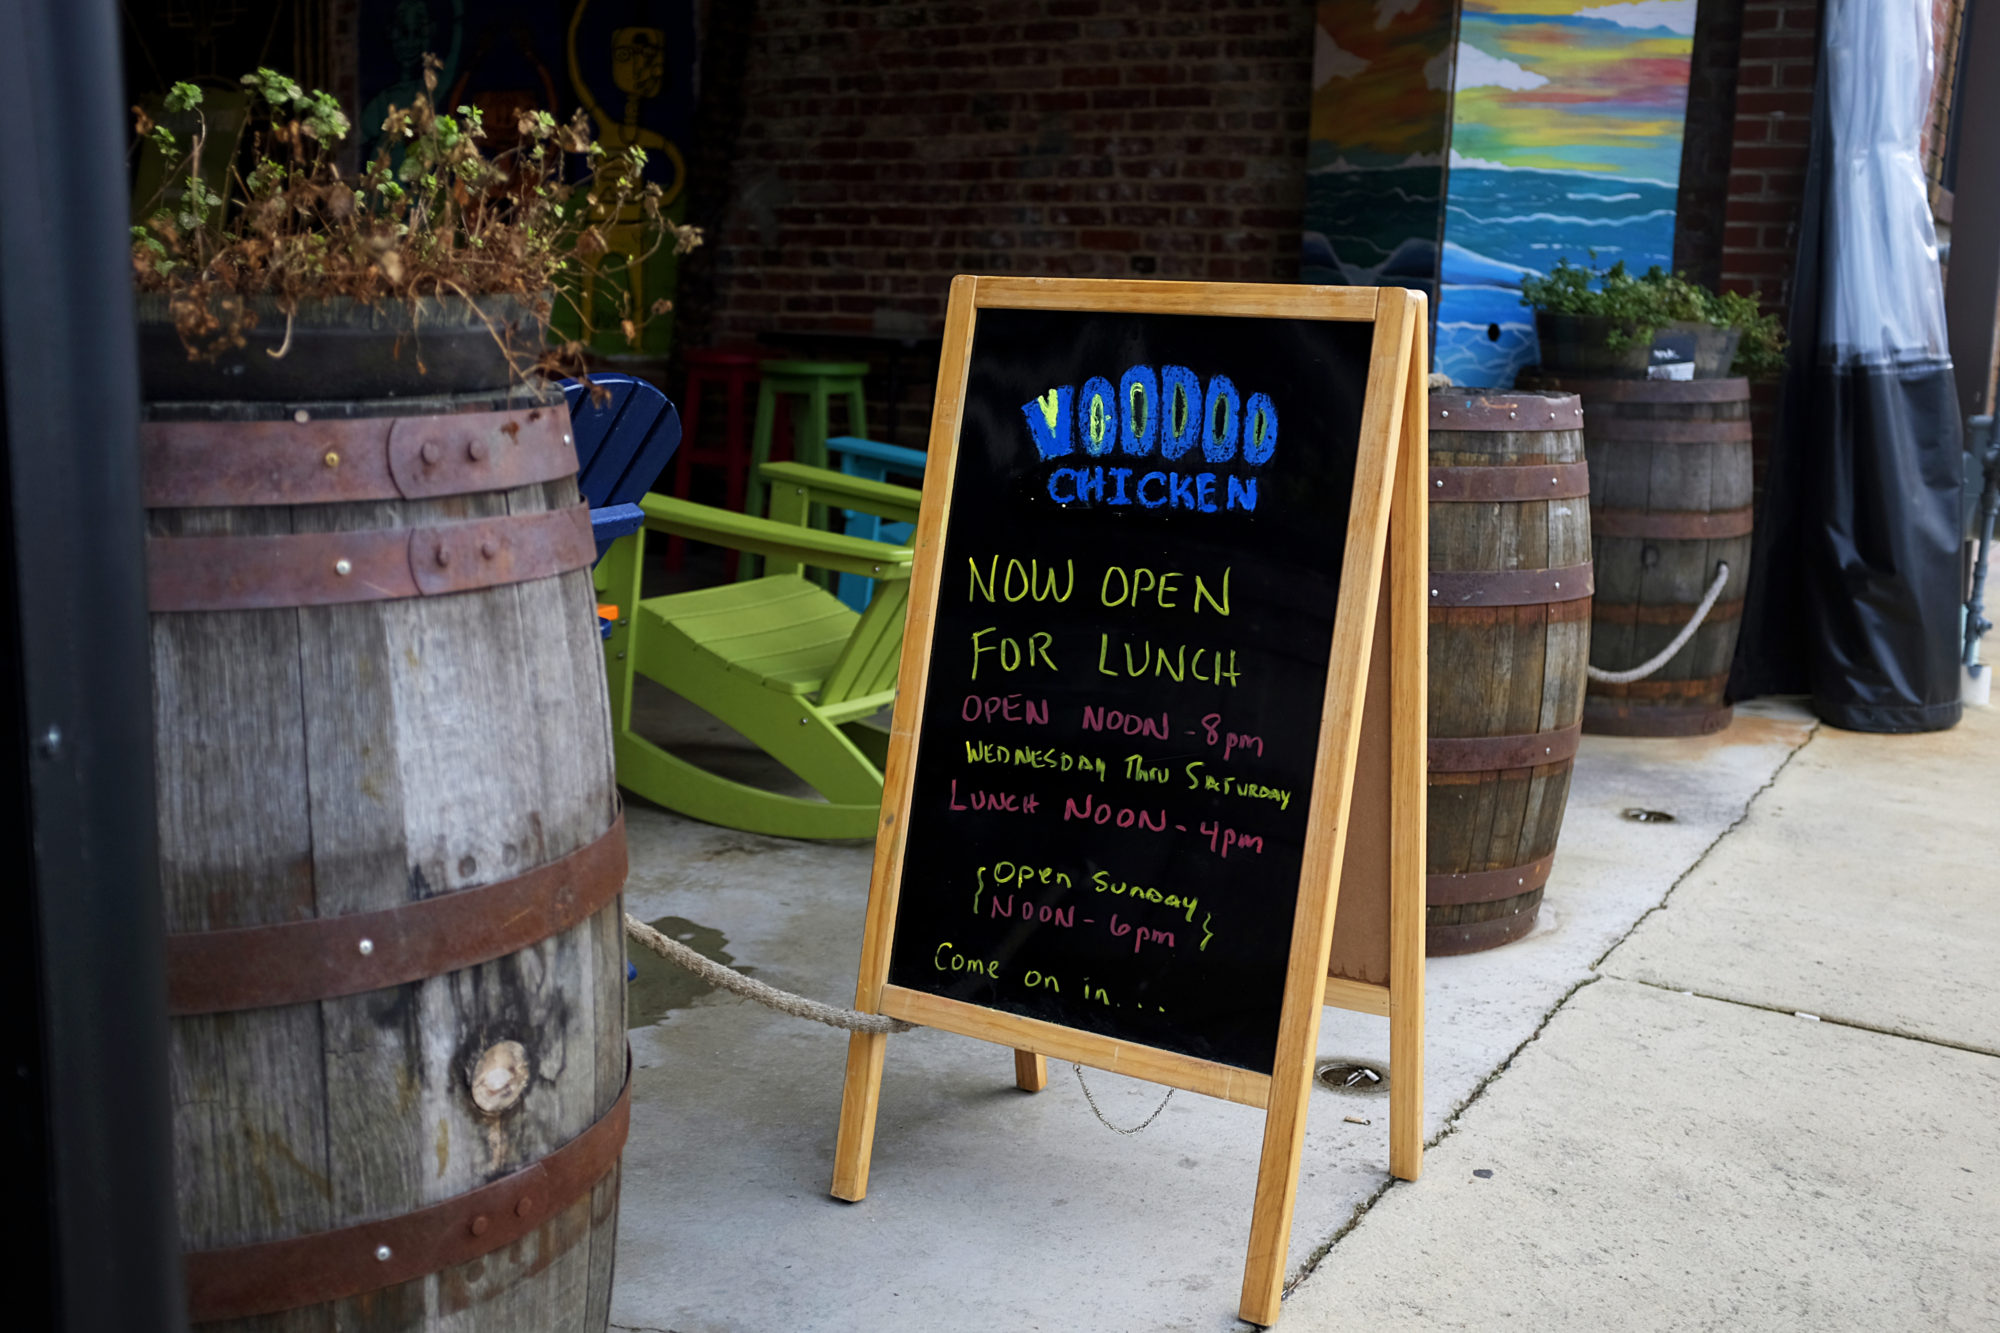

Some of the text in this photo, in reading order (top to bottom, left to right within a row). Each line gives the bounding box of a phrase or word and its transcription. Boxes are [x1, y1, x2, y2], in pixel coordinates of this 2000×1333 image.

[1020, 364, 1279, 466] VOODOO
[1047, 466, 1259, 513] CHICKEN
[968, 555, 1231, 615] NOW OPEN
[971, 627, 1242, 687] FOR LUNCH
[961, 695, 1050, 724] OPEN
[1082, 704, 1169, 740] NOON
[949, 779, 1041, 813] LUNCH
[994, 861, 1072, 888] Open
[934, 942, 1000, 978] Come
[1024, 970, 1060, 992] on
